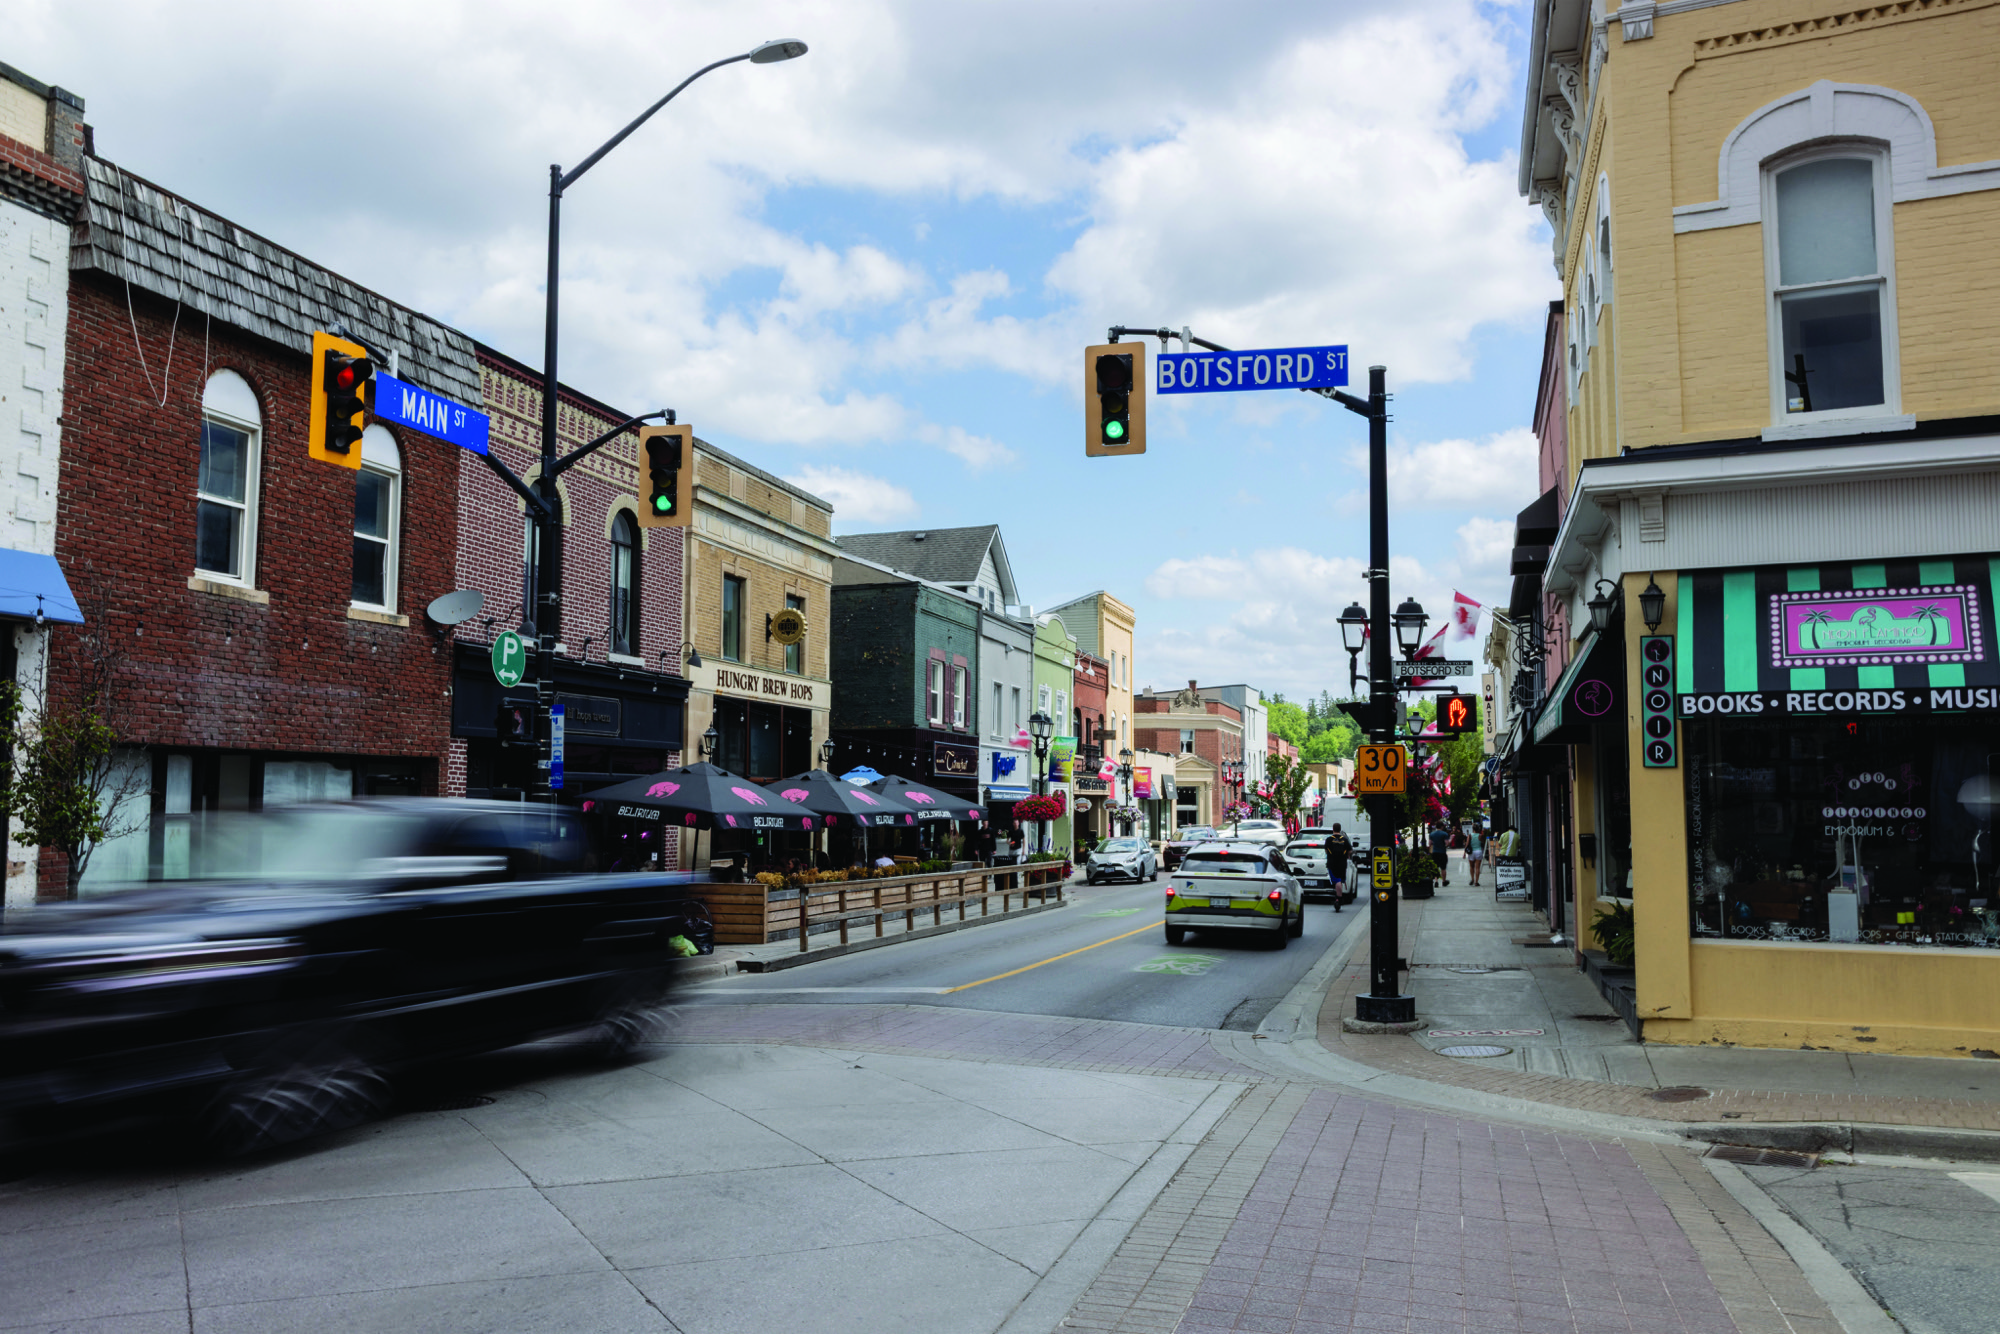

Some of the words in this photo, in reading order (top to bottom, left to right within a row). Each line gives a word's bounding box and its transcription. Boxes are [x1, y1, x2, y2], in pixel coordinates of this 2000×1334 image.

[1158, 353, 1315, 389] BOTSFORD
[1326, 352, 1346, 370] ST
[402, 387, 448, 435] MAIN
[454, 410, 467, 429] ST
[1822, 629, 1857, 640] NEON
[503, 636, 518, 665] P
[1400, 666, 1452, 675] BOTSFORD
[1454, 666, 1467, 675] ST
[717, 669, 760, 692] HUNGRY
[762, 677, 788, 696] BREW
[790, 683, 813, 701] HOPS
[1650, 668, 1666, 760] NOIR
[1682, 693, 1764, 714] BOOKS
[1786, 690, 1906, 712] RECORDS
[1930, 688, 2000, 709] MUSI
[576, 708, 592, 724] hops
[1364, 748, 1400, 772] 30
[1366, 773, 1398, 790] km/h
[1690, 754, 1701, 803] ACCESSORIES
[1850, 773, 1895, 789] NEON
[1692, 804, 1702, 837] FASHION
[1824, 808, 1924, 818] FLAMINGO
[1825, 825, 1883, 836] EMPORIUM
[1886, 826, 1895, 836] &
[1694, 848, 1703, 874] LAMPS
[1694, 875, 1704, 905] UNIQUE
[1731, 925, 1765, 935] BOOKS
[1895, 930, 1920, 940] GIFTS
[1935, 932, 1989, 943] STATIONERY
